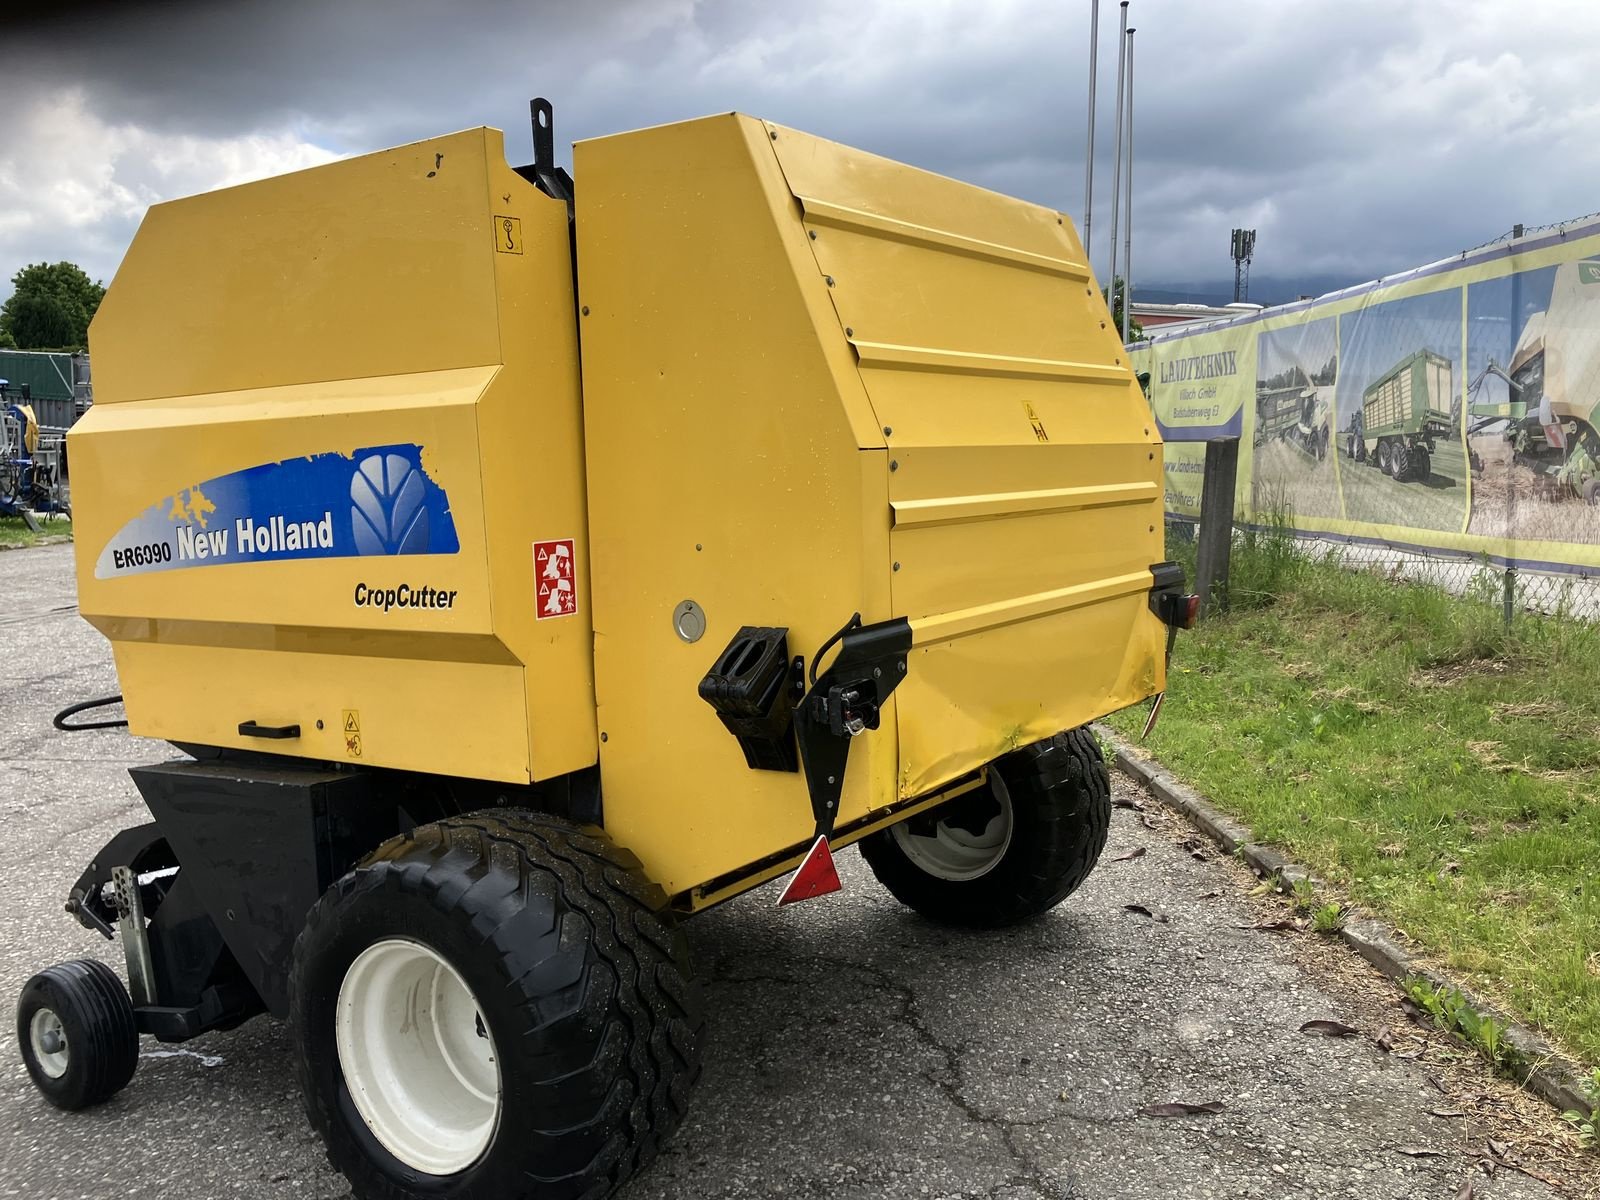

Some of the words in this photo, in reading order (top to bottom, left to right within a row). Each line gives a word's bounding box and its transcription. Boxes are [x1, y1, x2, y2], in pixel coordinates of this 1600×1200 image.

[1160, 350, 1237, 384] LANDTECHNIK
[1198, 386, 1217, 400] GmbH
[176, 525, 227, 560] New
[235, 512, 333, 553] Holland
[354, 582, 458, 613] CropCutter
